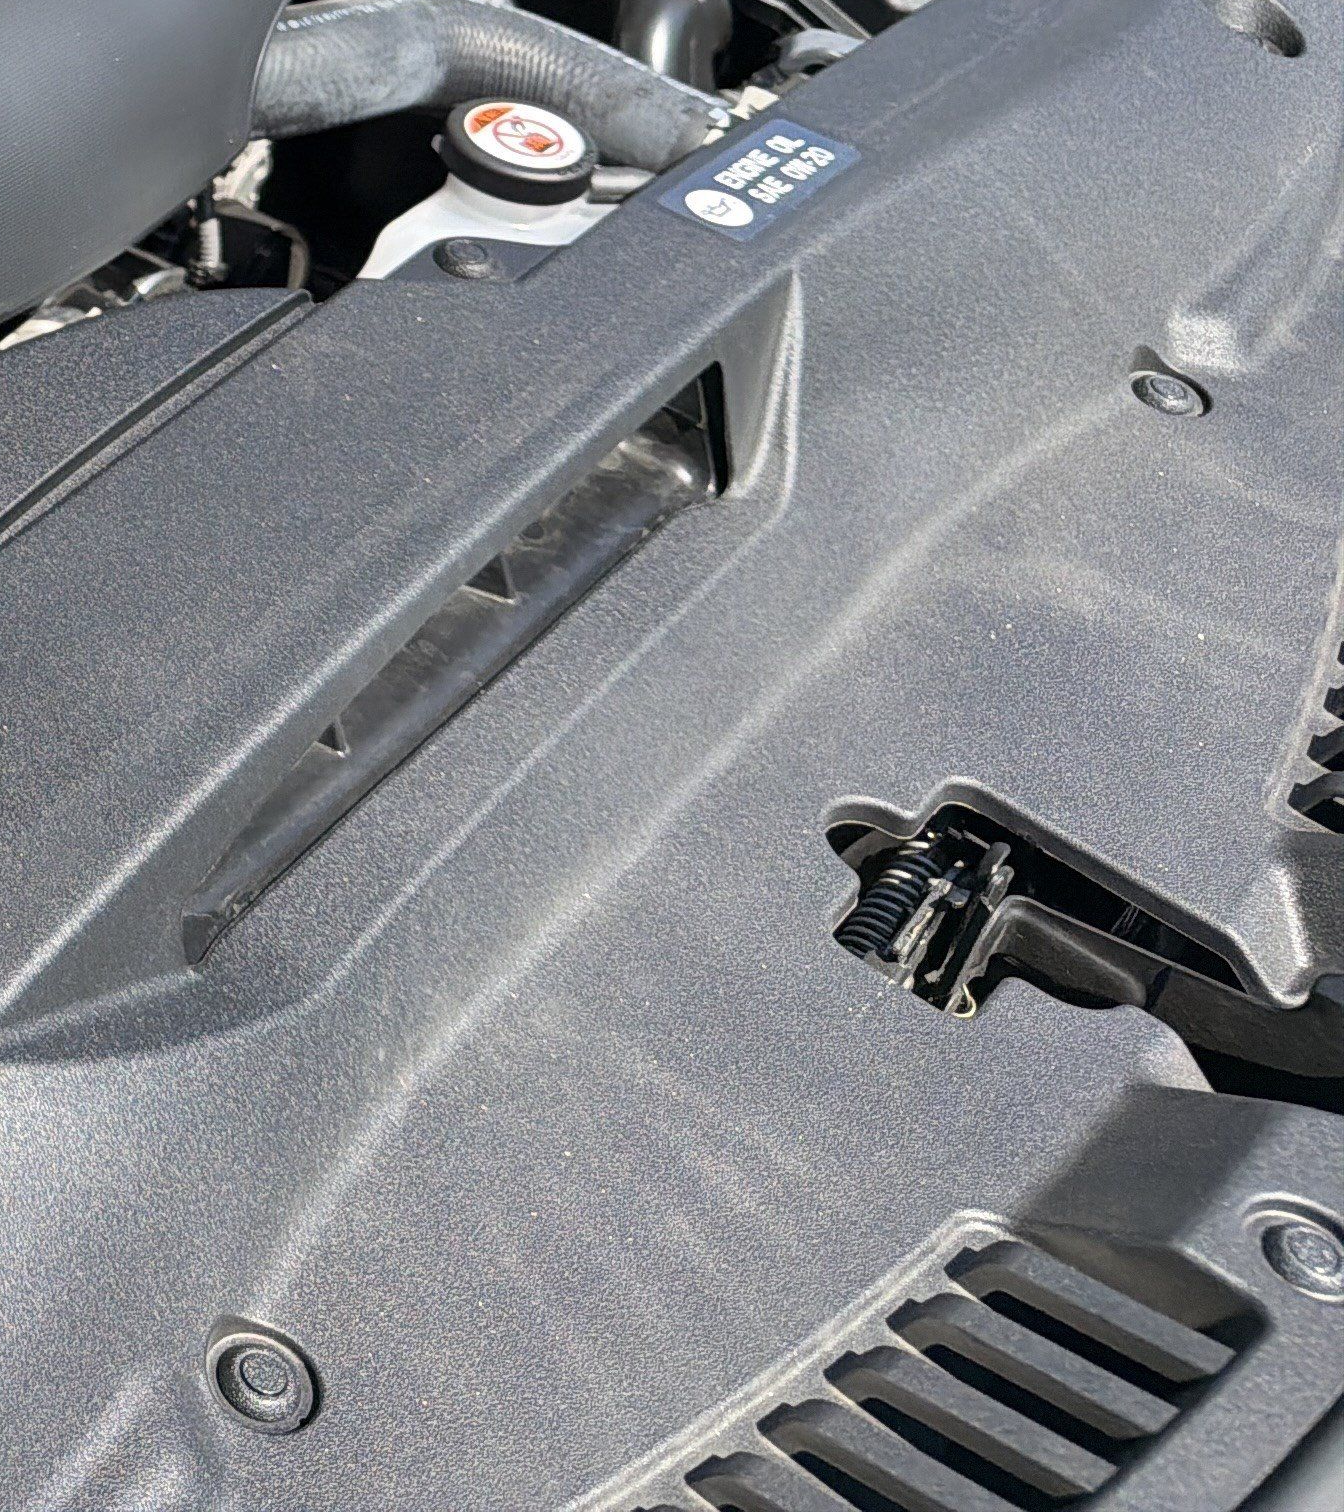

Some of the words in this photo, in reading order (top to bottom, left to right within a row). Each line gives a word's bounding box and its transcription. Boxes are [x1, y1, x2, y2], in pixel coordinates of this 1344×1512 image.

[713, 148, 781, 191] ENGINE
[765, 134, 806, 155] OIL
[747, 175, 795, 205] SAE
[779, 146, 836, 181] 0W-20
